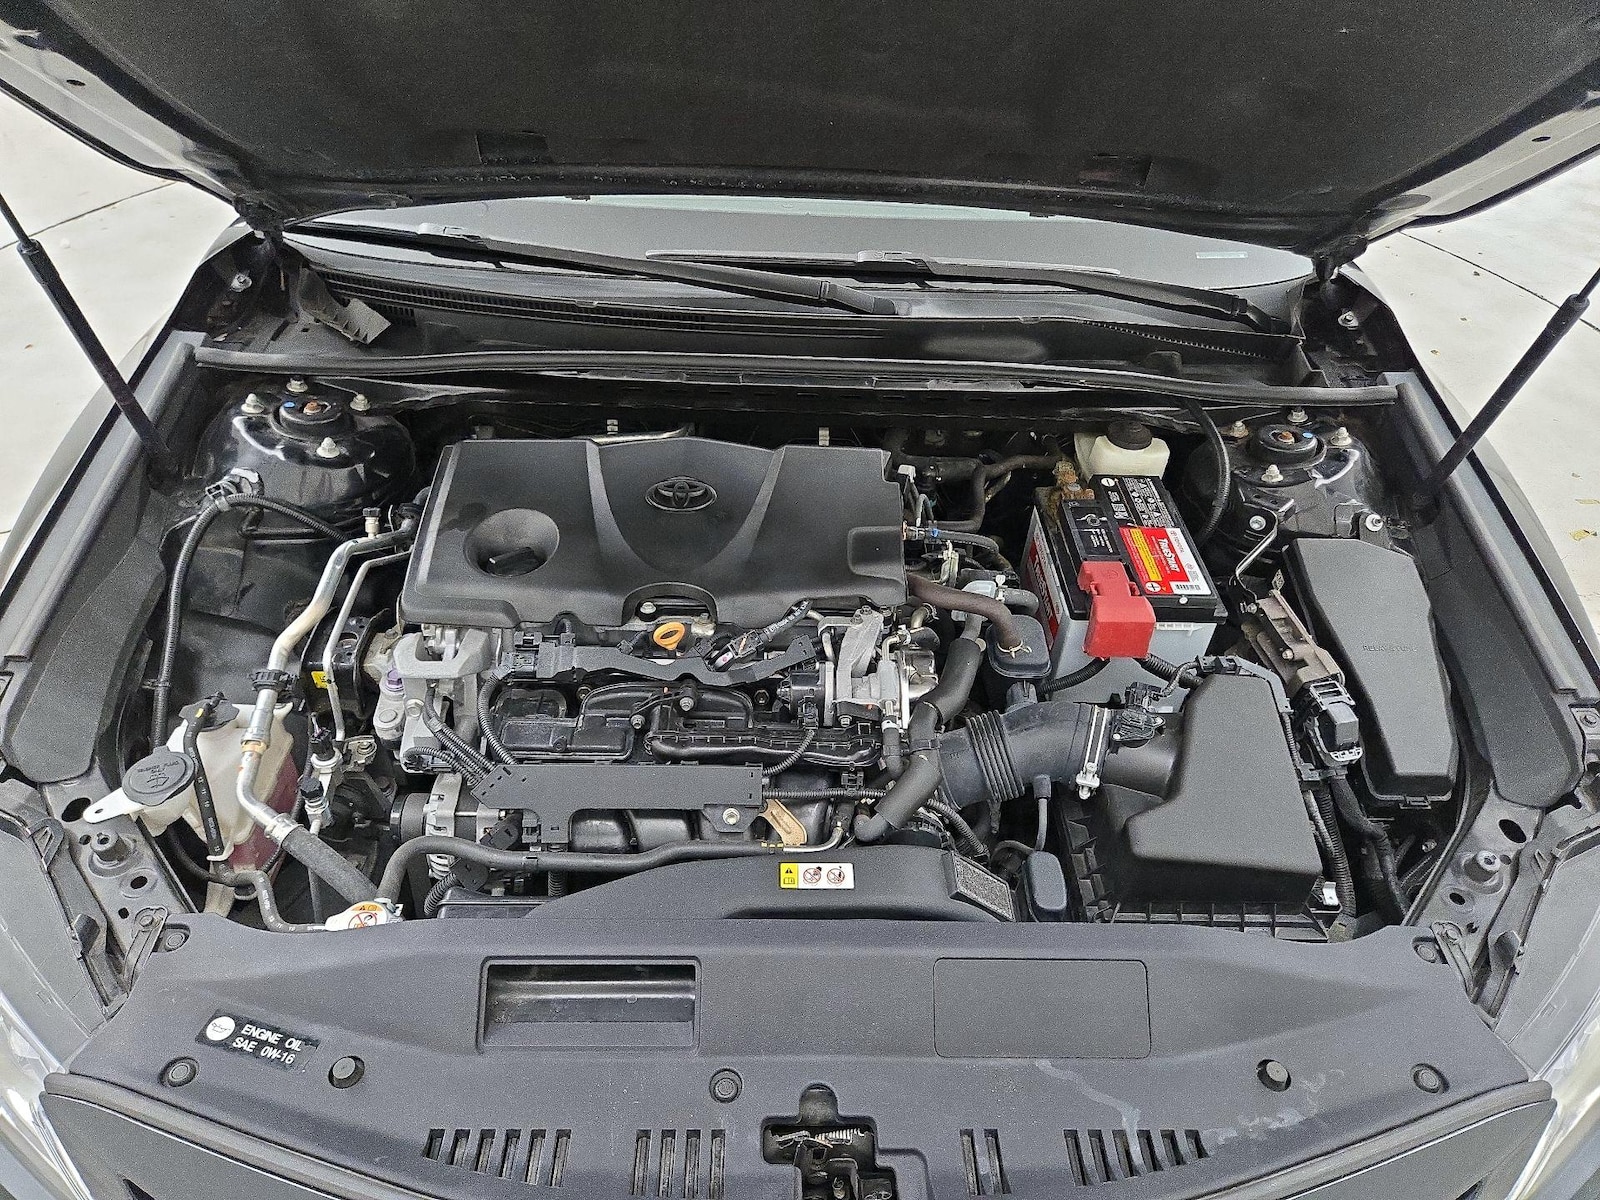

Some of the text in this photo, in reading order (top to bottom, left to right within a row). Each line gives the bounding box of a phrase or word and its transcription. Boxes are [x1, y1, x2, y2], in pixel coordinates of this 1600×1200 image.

[232, 1036, 296, 1064] SAE 0W-16
[240, 1023, 303, 1051] ENGINE OIL
